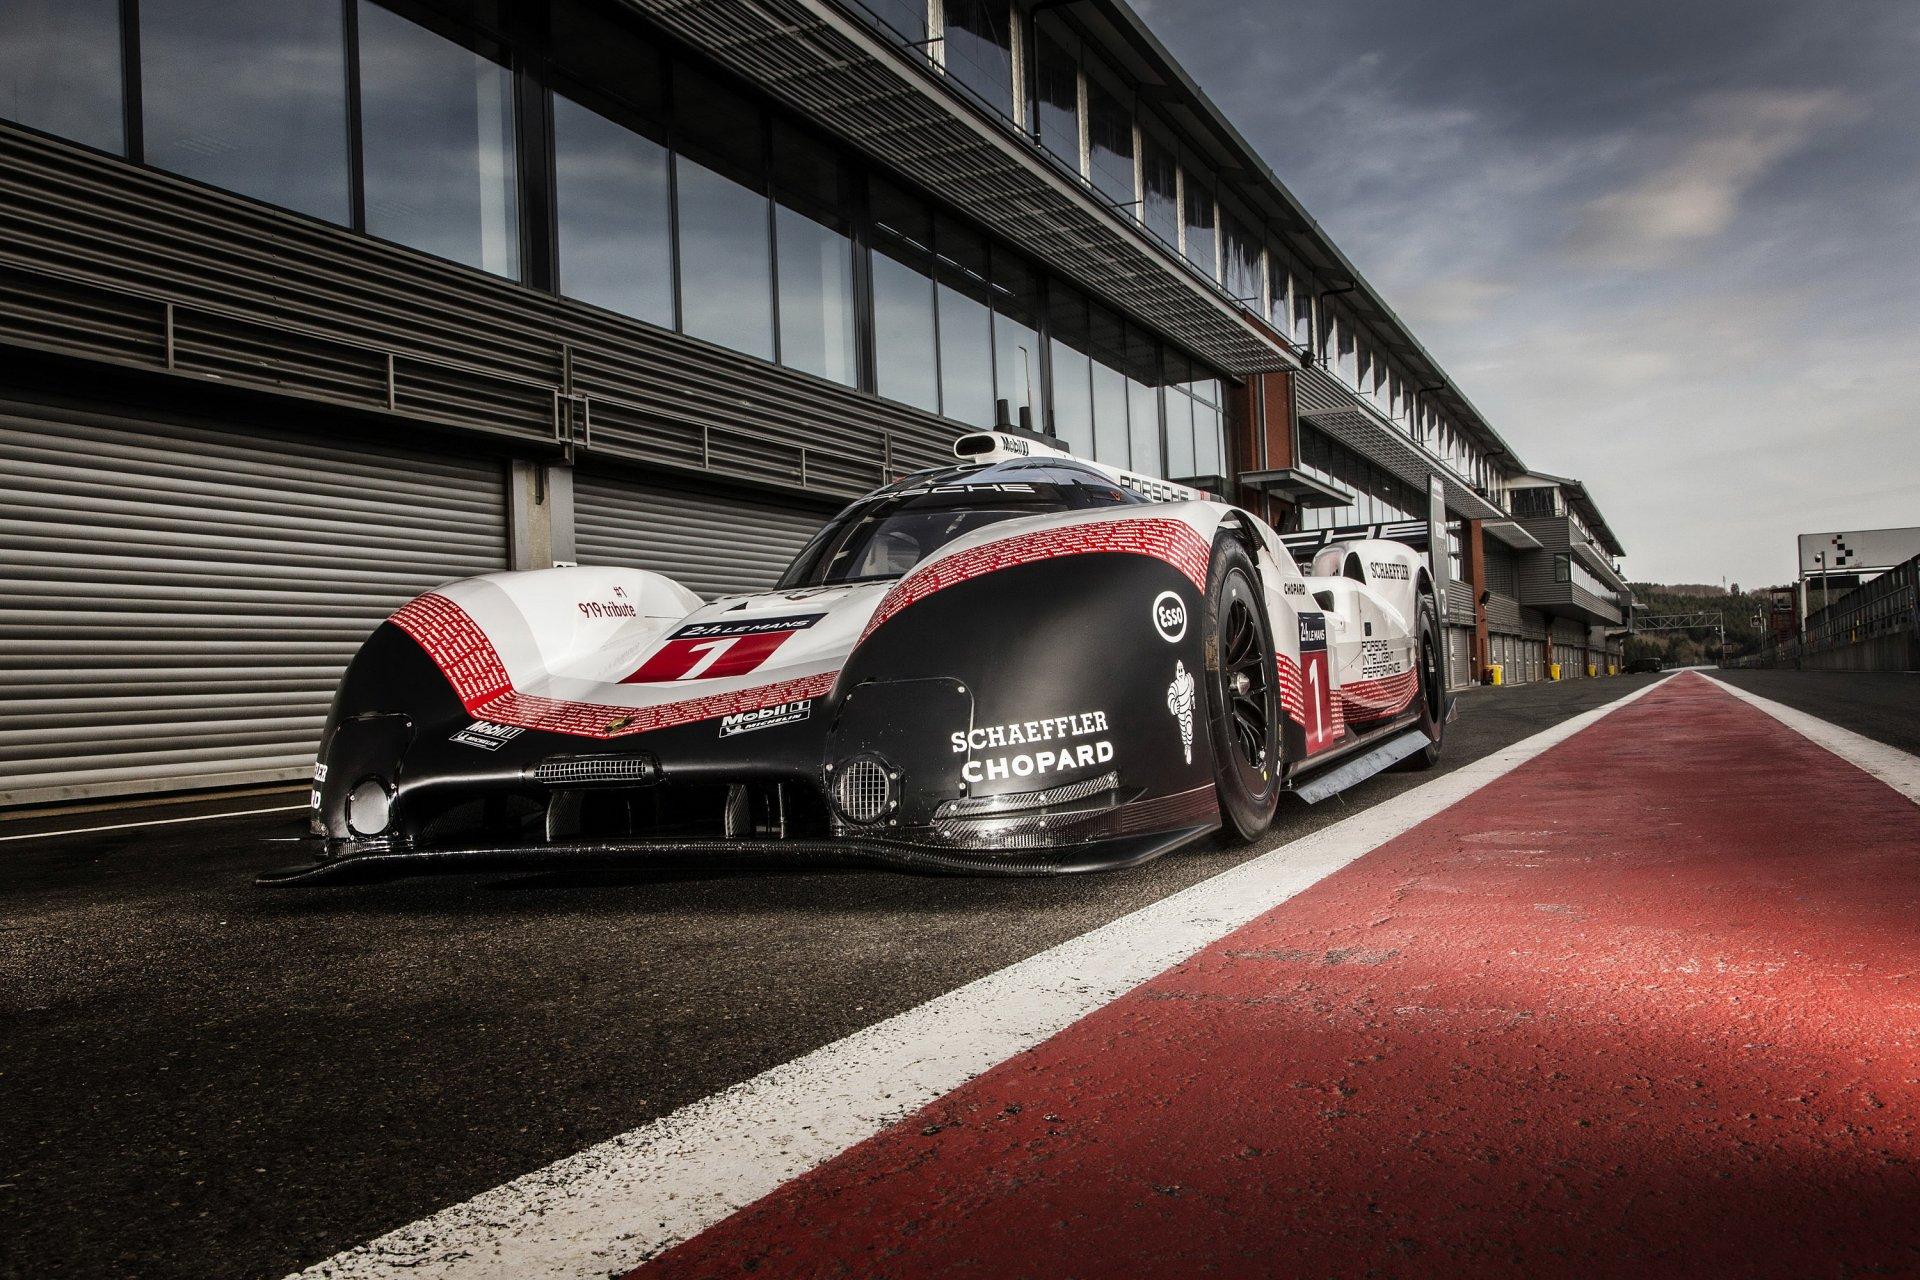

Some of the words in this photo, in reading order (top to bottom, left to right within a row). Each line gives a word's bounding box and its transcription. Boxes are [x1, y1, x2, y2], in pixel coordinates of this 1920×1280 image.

[1120, 475, 1189, 502] PORSCHE
[1370, 561, 1410, 581] SCHAEFFLER
[613, 586, 628, 598] #1
[1284, 582, 1306, 596] CHOPARD
[578, 602, 602, 618] 919
[601, 601, 636, 617] tribute
[1158, 605, 1183, 628] Esso
[749, 620, 810, 632] MANS
[1361, 639, 1388, 653] PORSCHE
[676, 637, 742, 681] 1
[1362, 651, 1394, 666] INTELLIGENT
[1362, 662, 1401, 680] PERFORMANCE
[1309, 659, 1323, 744] 1
[722, 703, 787, 727] Mobil
[745, 713, 802, 730] MICHELIN
[466, 721, 512, 737] Mobil
[951, 711, 1109, 753] SCHAEFFLER
[961, 741, 1115, 783] CHOPARD
